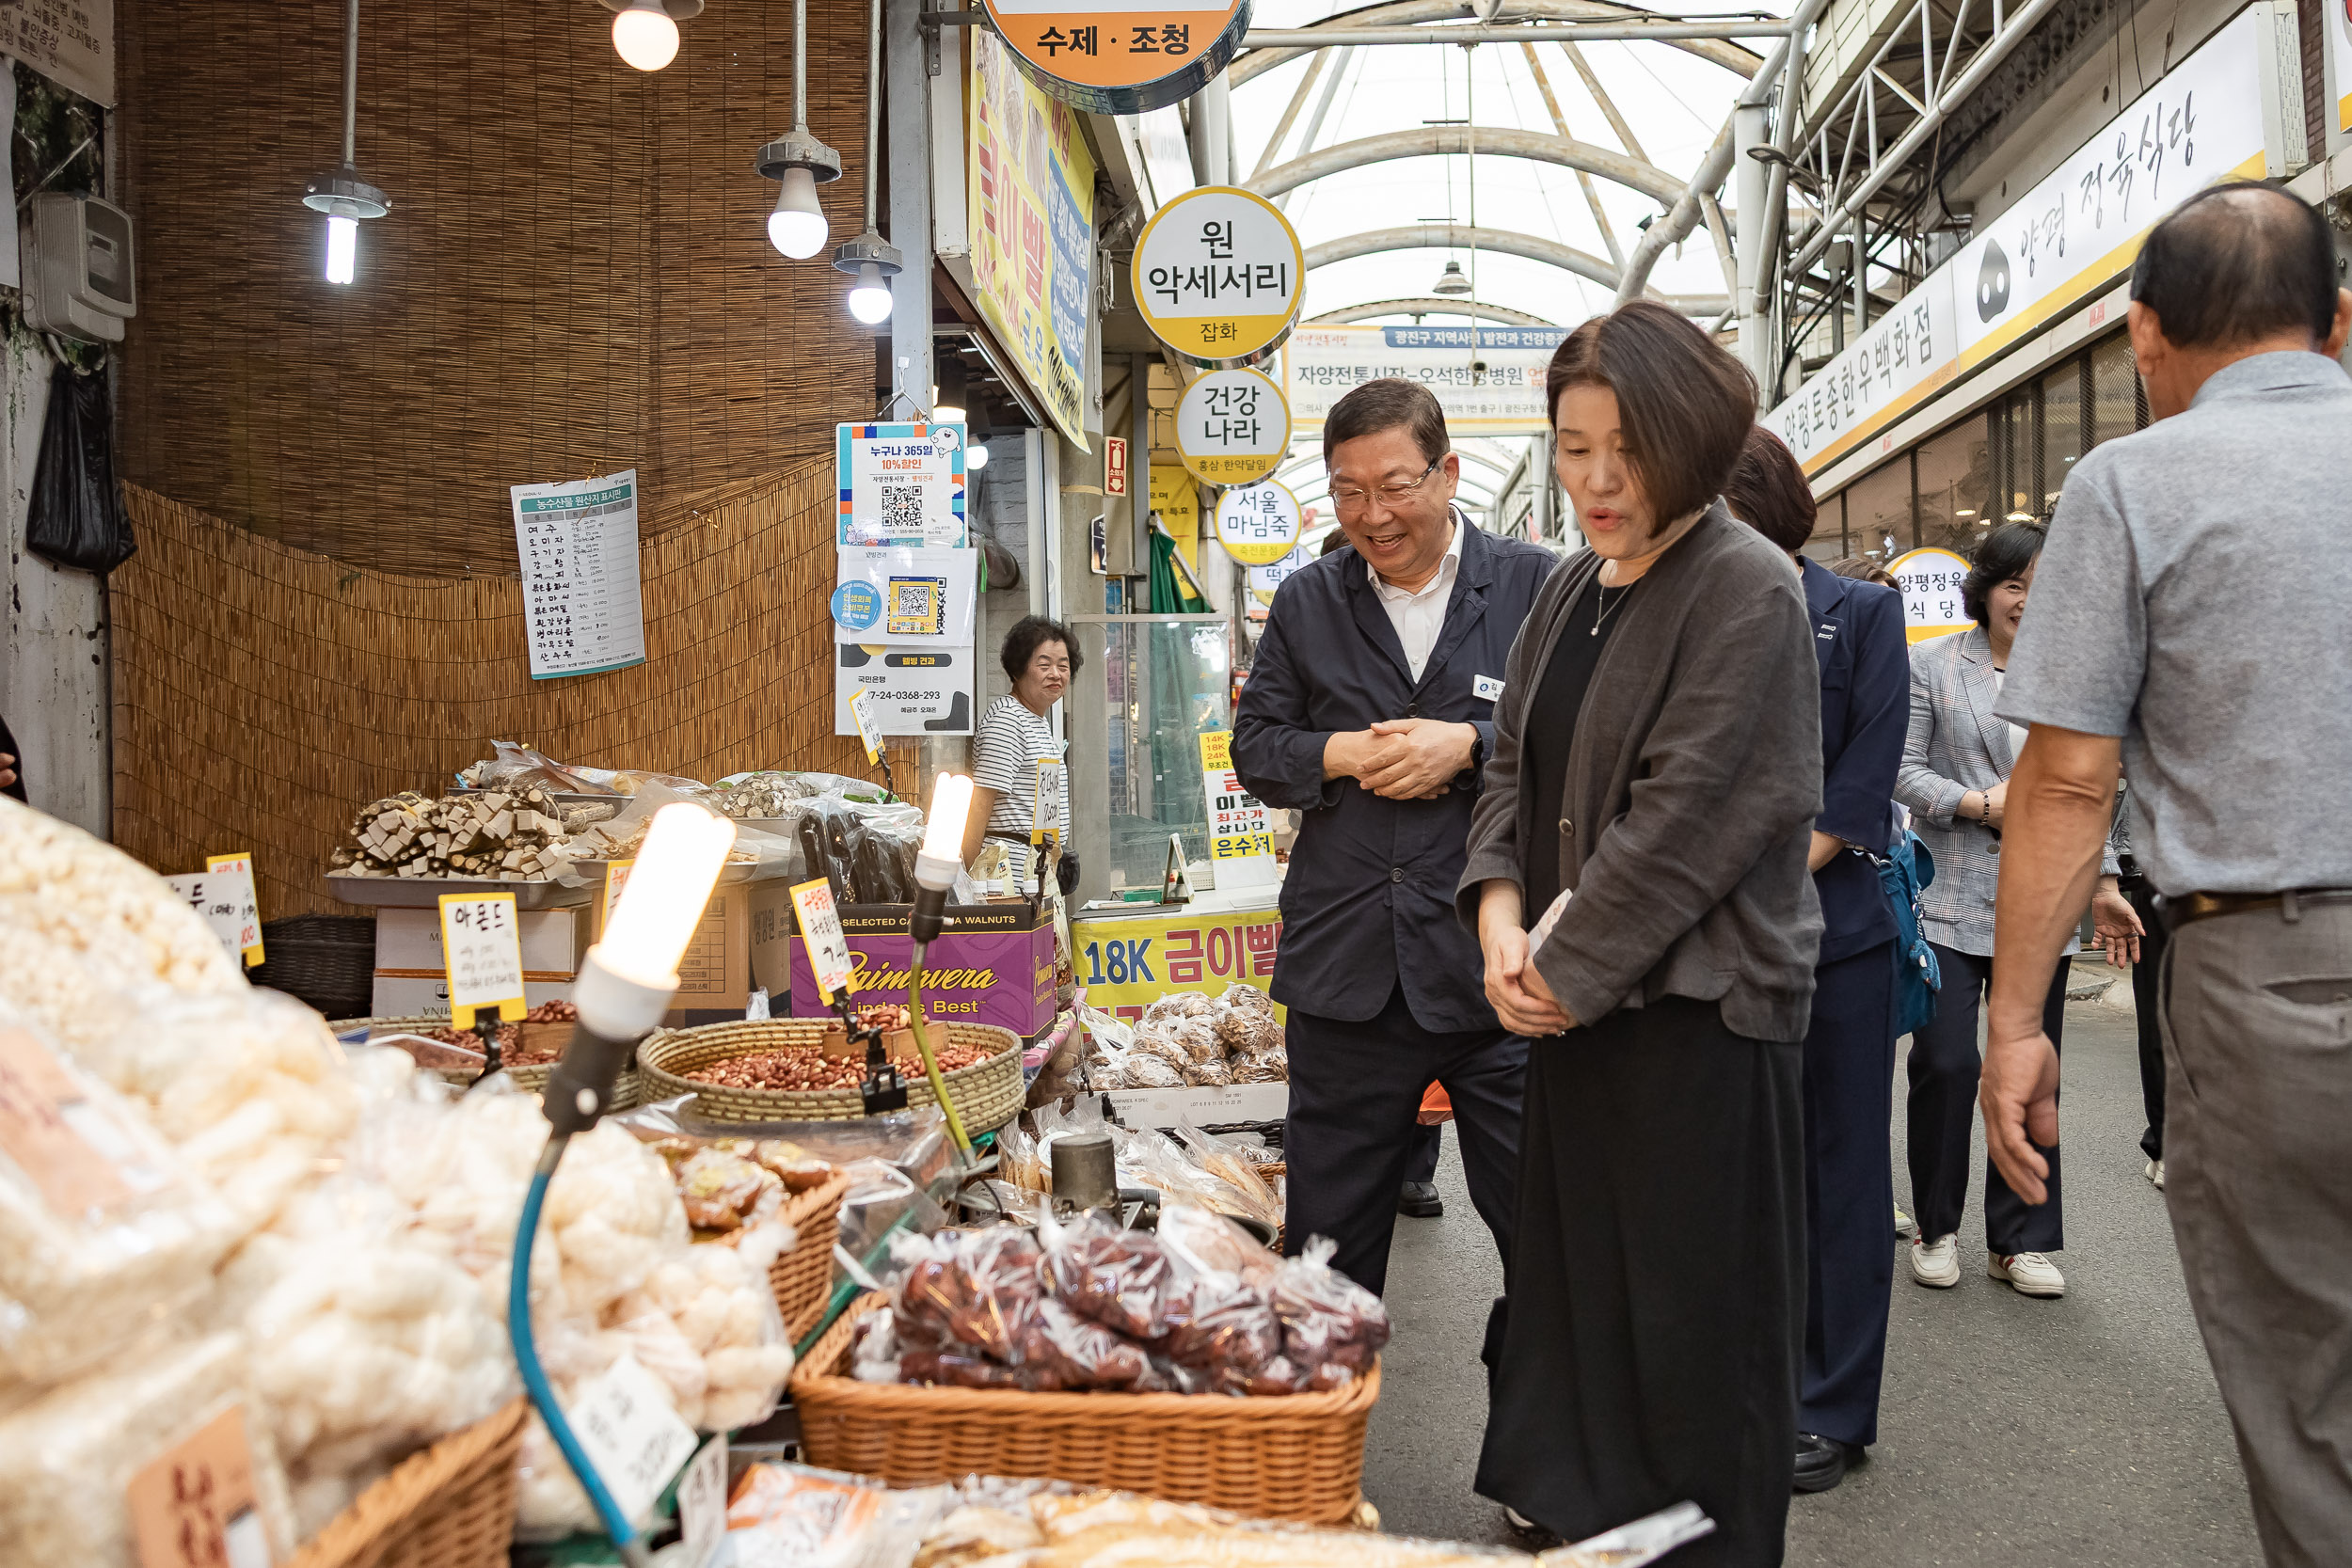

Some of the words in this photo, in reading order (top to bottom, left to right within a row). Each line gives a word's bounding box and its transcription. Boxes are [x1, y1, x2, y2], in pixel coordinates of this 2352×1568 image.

[1037, 25, 1098, 56] 수제
[1128, 24, 1190, 55] 조청
[2021, 192, 2065, 277] 양평
[2080, 89, 2198, 230] 정육식당
[1199, 220, 1234, 259] 원
[1148, 263, 1287, 305] 악세서리
[1200, 321, 1238, 342] 잡화
[1395, 330, 1431, 344] 광진구
[1484, 331, 1519, 345] 발전과
[1298, 364, 1523, 387] 자양전통시장-오석한병원
[1785, 296, 1931, 455] 양평토종한우백화점
[1204, 385, 1261, 417] 건강
[1204, 419, 1261, 446] 나라
[870, 446, 901, 457] 누구나
[904, 445, 933, 456] 365일
[882, 459, 922, 470] 10%할인
[872, 475, 905, 483] 자양전통시장
[536, 499, 574, 511] 농수산물
[575, 494, 599, 508] 원산지
[600, 489, 621, 501] 표시판
[1238, 490, 1279, 514] 서울
[1228, 515, 1290, 537] 마님죽
[920, 657, 935, 665] 견과
[868, 690, 941, 700] 7-24-0368-293
[1206, 735, 1225, 743] 14K
[1207, 743, 1226, 752] 18K
[1207, 752, 1227, 760] 24K
[455, 904, 504, 931] 아몬드
[965, 915, 1016, 925] WALNUTS
